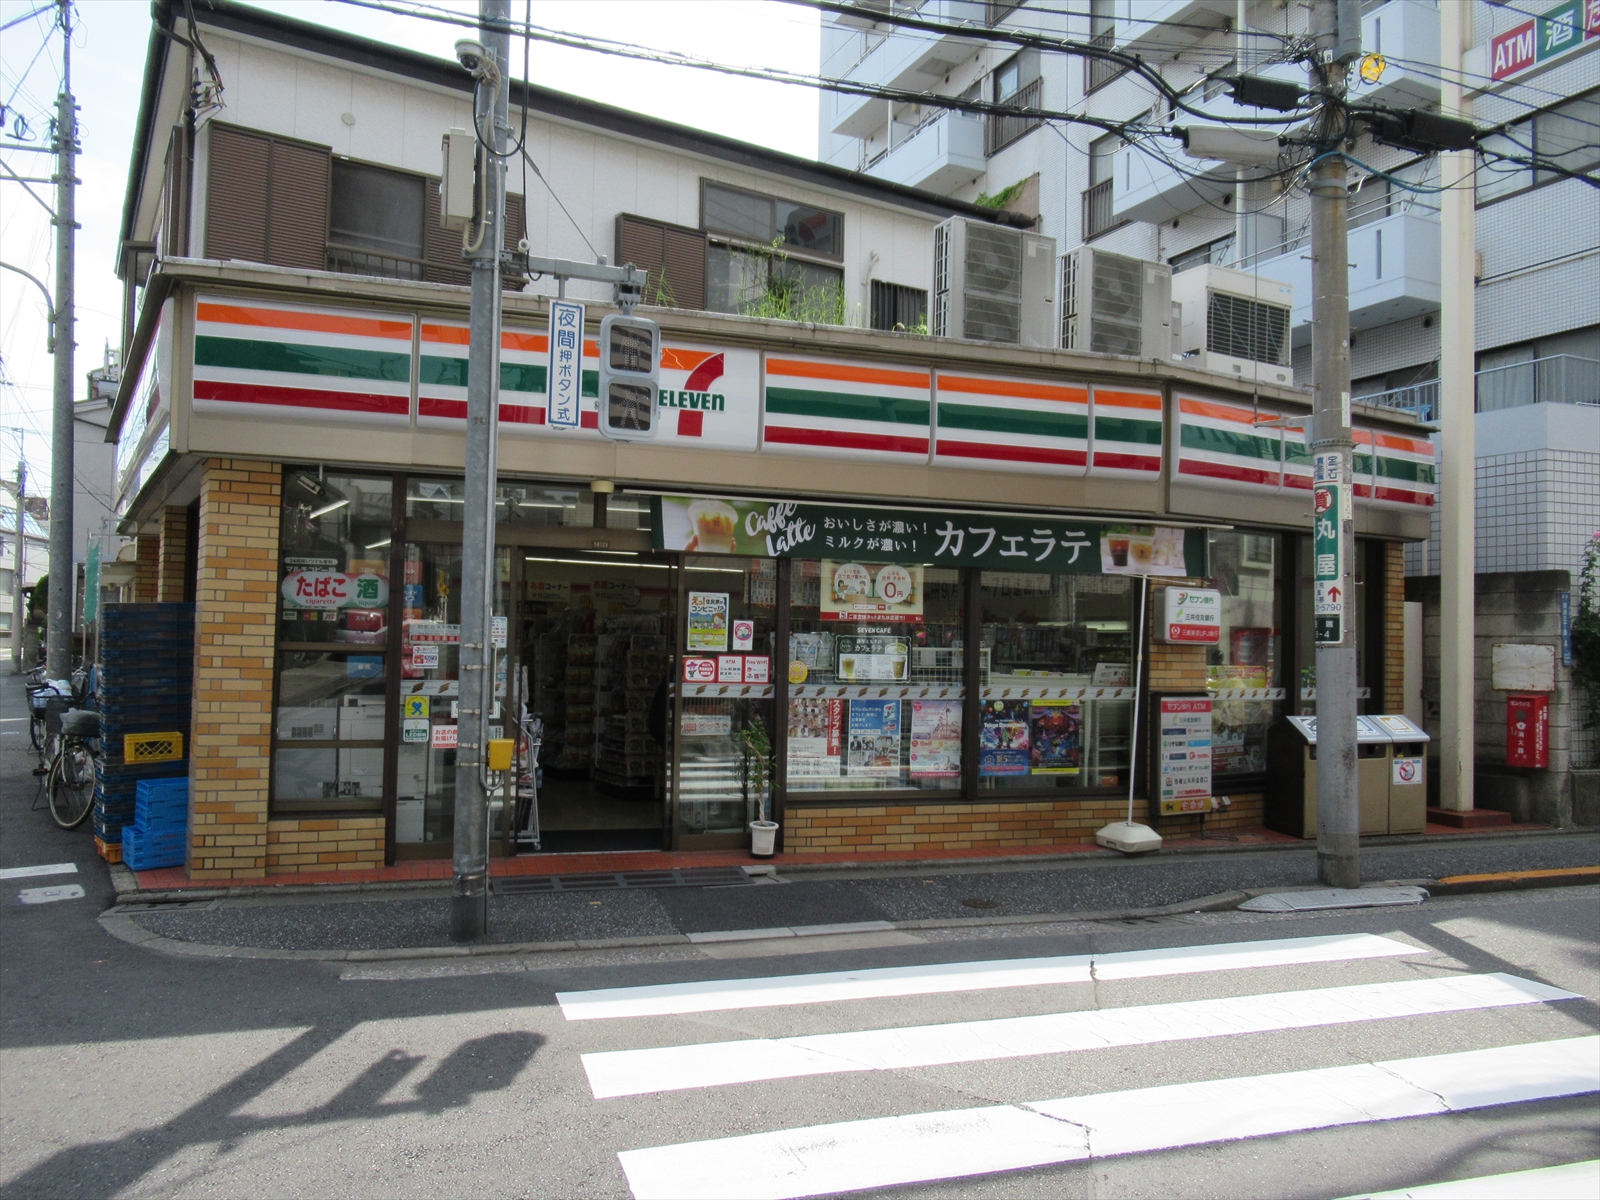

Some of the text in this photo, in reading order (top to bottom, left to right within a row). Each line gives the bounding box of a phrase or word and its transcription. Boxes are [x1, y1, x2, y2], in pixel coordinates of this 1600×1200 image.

[1494, 29, 1533, 74] ATM
[1545, 8, 1575, 51] 酒
[557, 307, 577, 421] 夜間押ボタン式
[823, 516, 929, 535] おいしさが濃い！
[825, 535, 917, 553] ミルクが濃い！
[934, 520, 1092, 565] カフェラテ
[1317, 518, 1336, 576] 丸屋
[296, 575, 347, 598] たばこ
[356, 577, 379, 599] 酒
[1189, 595, 1214, 604] セブン銀行
[1185, 613, 1215, 622] 三井住友銀行
[1182, 629, 1218, 637] 三菱東京UFJ銀行
[1192, 703, 1207, 711] ATM
[1517, 731, 1525, 754] 消火器
